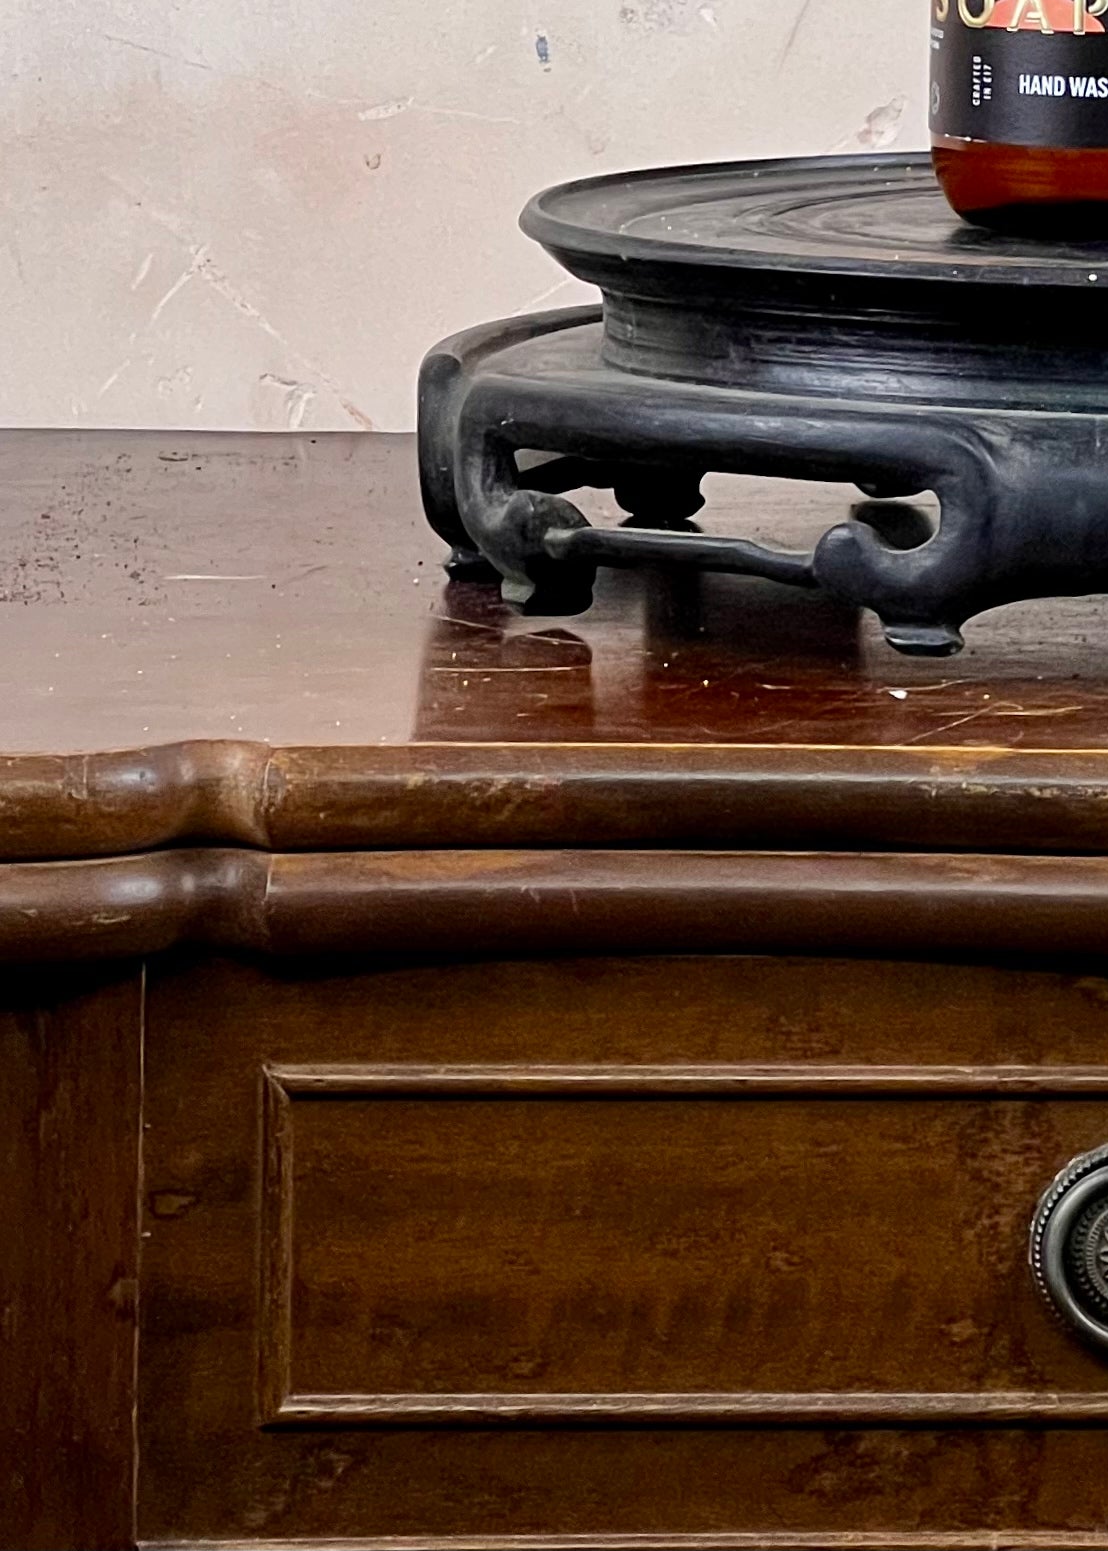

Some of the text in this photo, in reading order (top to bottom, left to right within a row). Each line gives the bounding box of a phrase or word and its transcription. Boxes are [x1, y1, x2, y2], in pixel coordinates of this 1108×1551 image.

[972, 55, 982, 106] CRAFTED
[1019, 74, 1066, 97] HAND
[982, 87, 992, 100] IN
